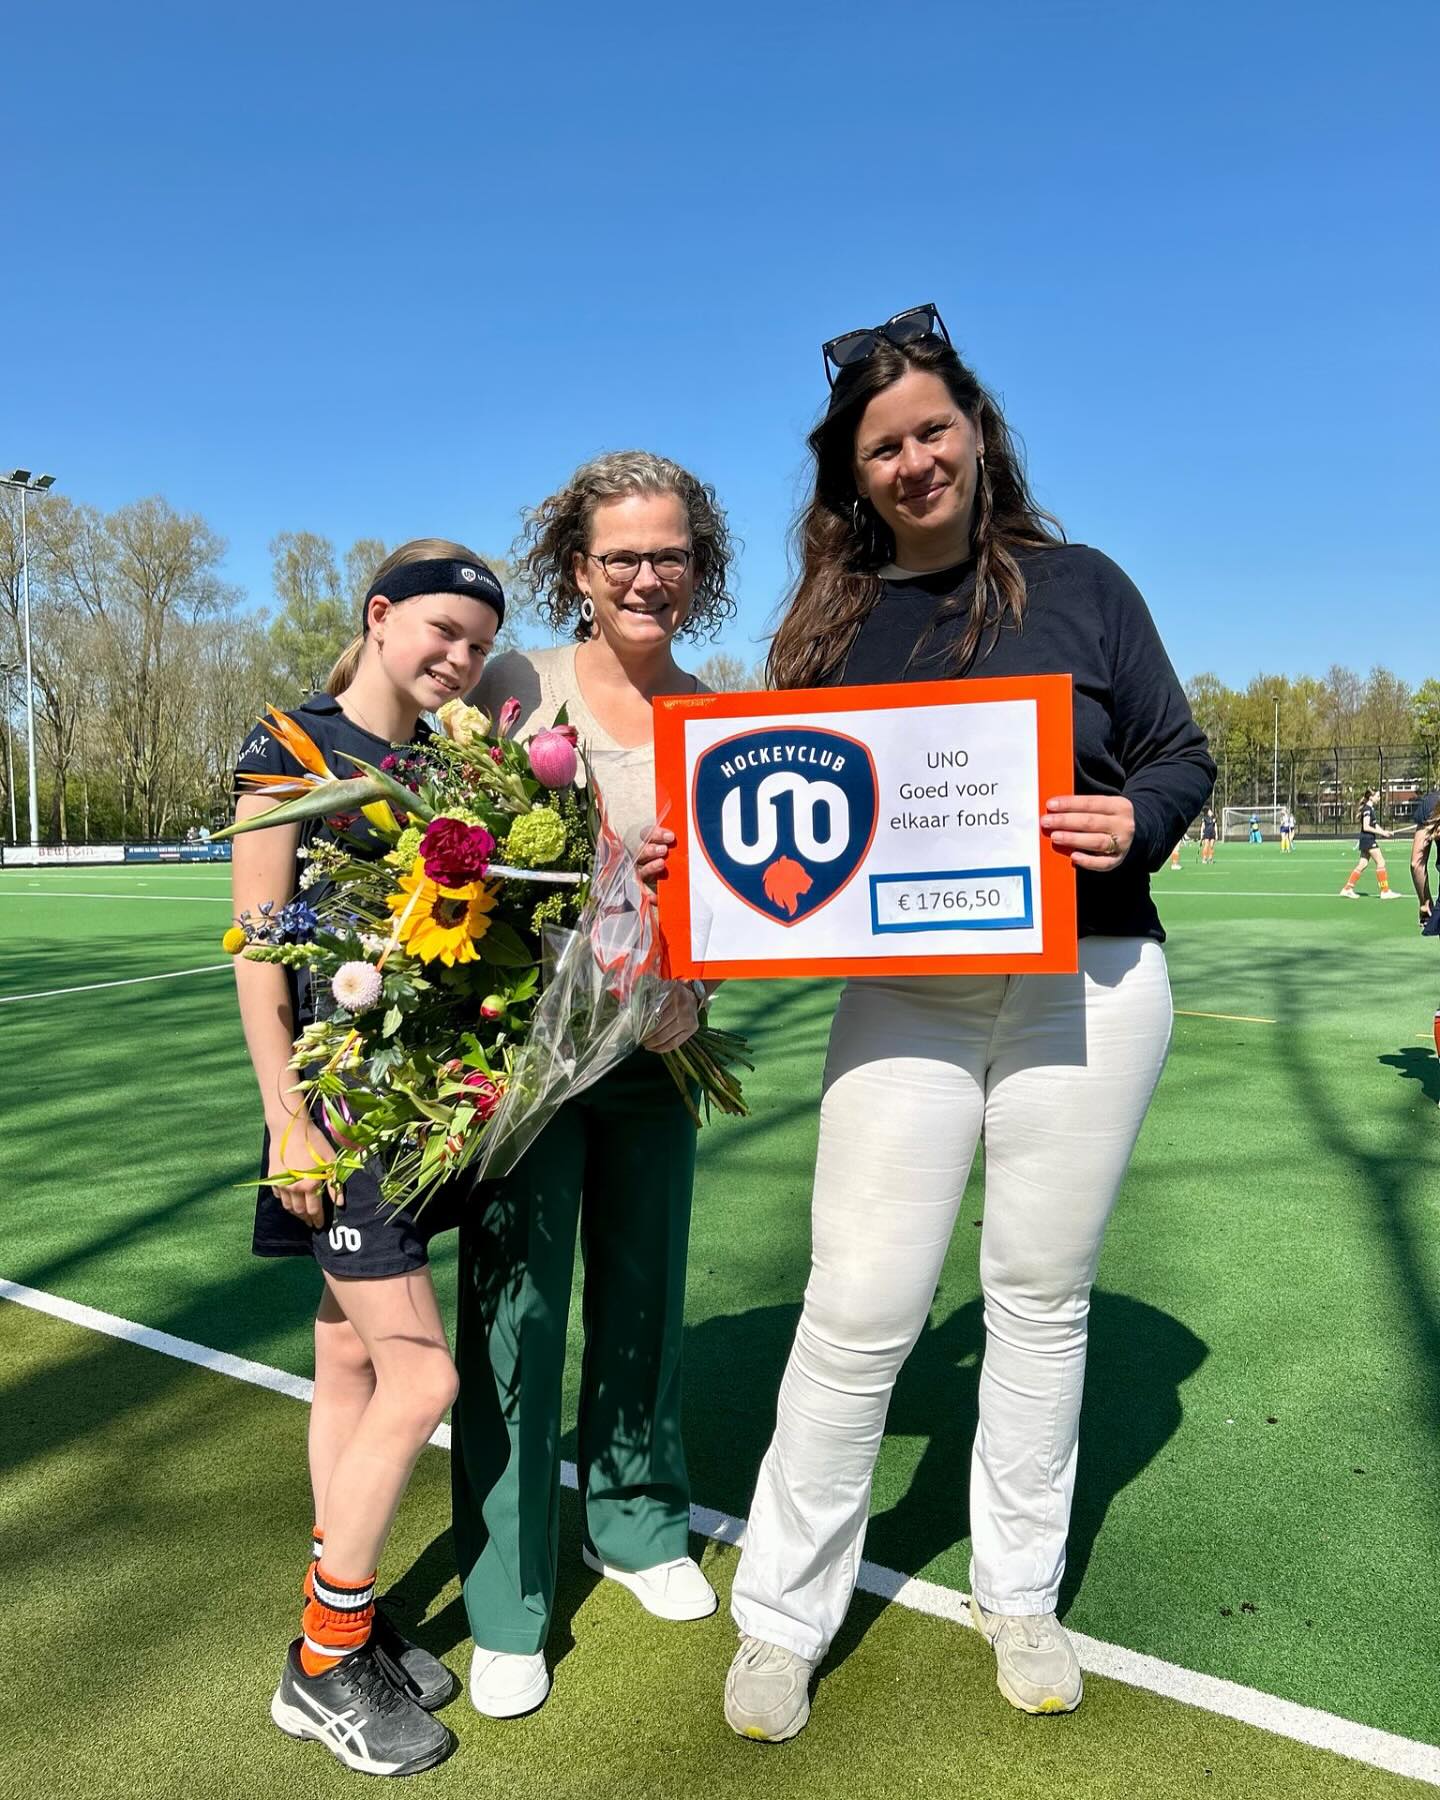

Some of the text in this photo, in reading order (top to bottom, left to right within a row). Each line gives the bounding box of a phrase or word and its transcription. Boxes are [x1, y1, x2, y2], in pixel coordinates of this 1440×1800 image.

[720, 745, 846, 778] HOCKEYCLUB
[927, 750, 969, 769] UNO
[899, 781, 999, 800] Goed voor
[890, 808, 1010, 830] elkaar fonds
[898, 889, 1001, 911] € 1766,50
